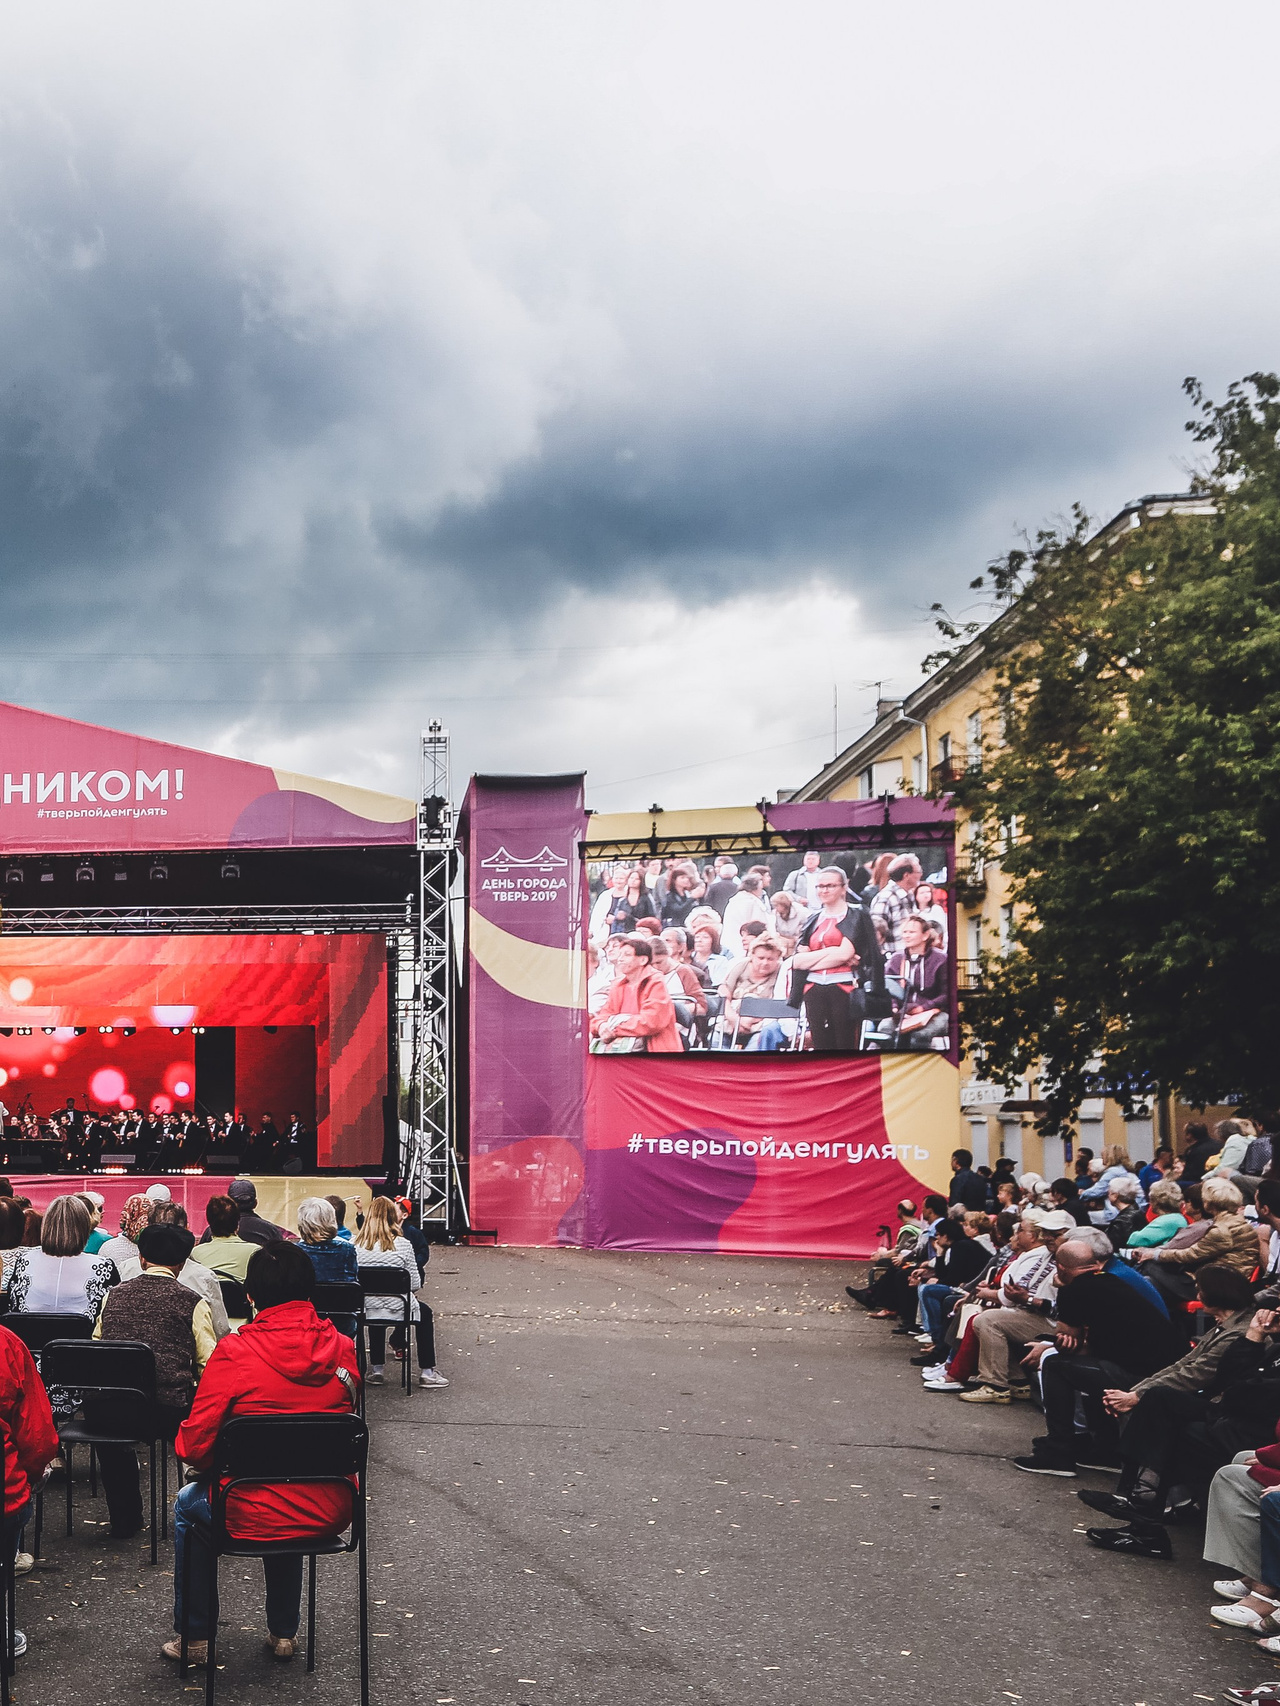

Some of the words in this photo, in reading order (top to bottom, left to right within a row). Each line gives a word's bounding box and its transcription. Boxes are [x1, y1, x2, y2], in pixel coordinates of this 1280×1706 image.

[37, 807, 168, 819] #тверьпойдемгулять
[482, 879, 515, 890] ДЕНЬ
[517, 878, 567, 889] ГОРОДА
[493, 891, 529, 902] ТВЕРЬ
[531, 891, 558, 901] 2019
[627, 1133, 930, 1164] #тверьпойдемгулять
